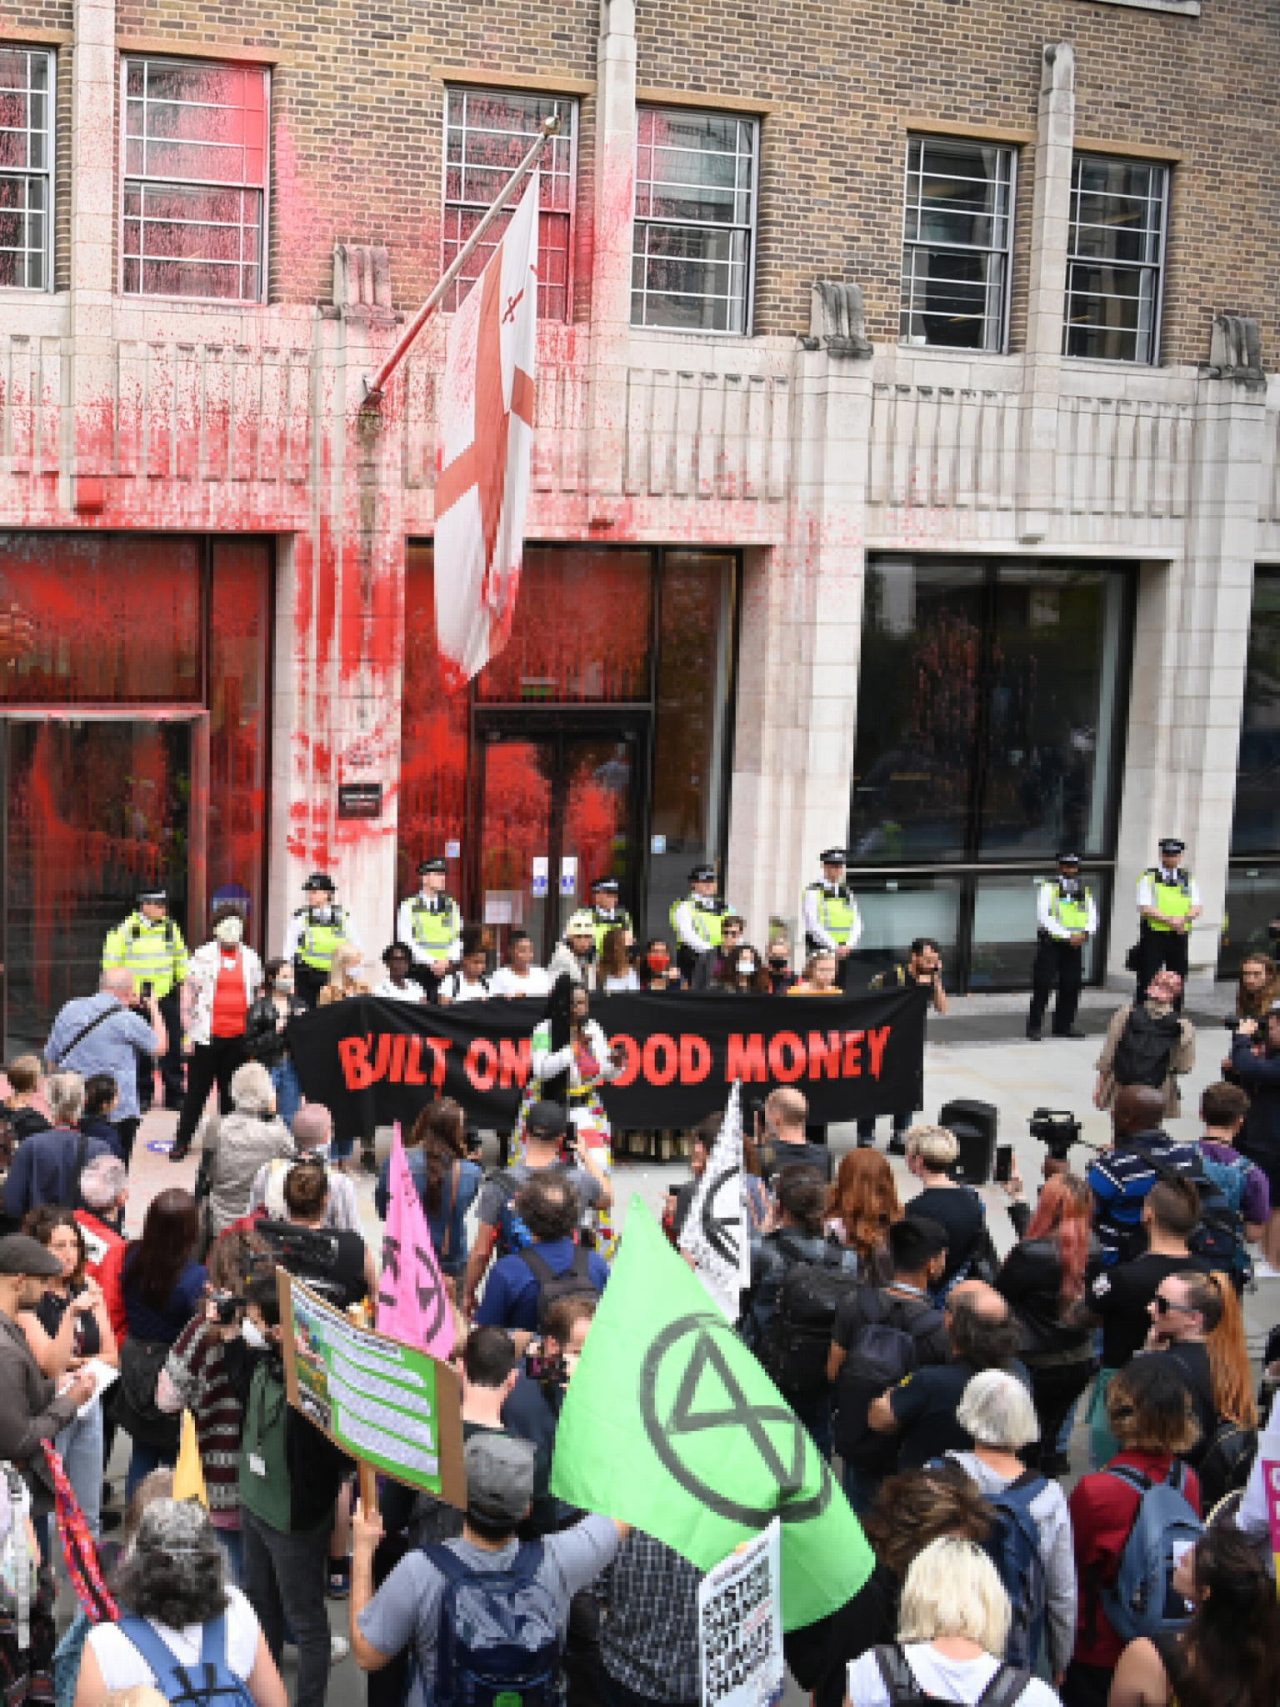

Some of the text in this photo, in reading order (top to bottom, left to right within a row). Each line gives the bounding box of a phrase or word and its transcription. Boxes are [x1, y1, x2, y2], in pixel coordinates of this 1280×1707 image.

[338, 1032, 453, 1100] BUILT
[463, 1037, 532, 1092] ON
[725, 1026, 891, 1083] MONEY
